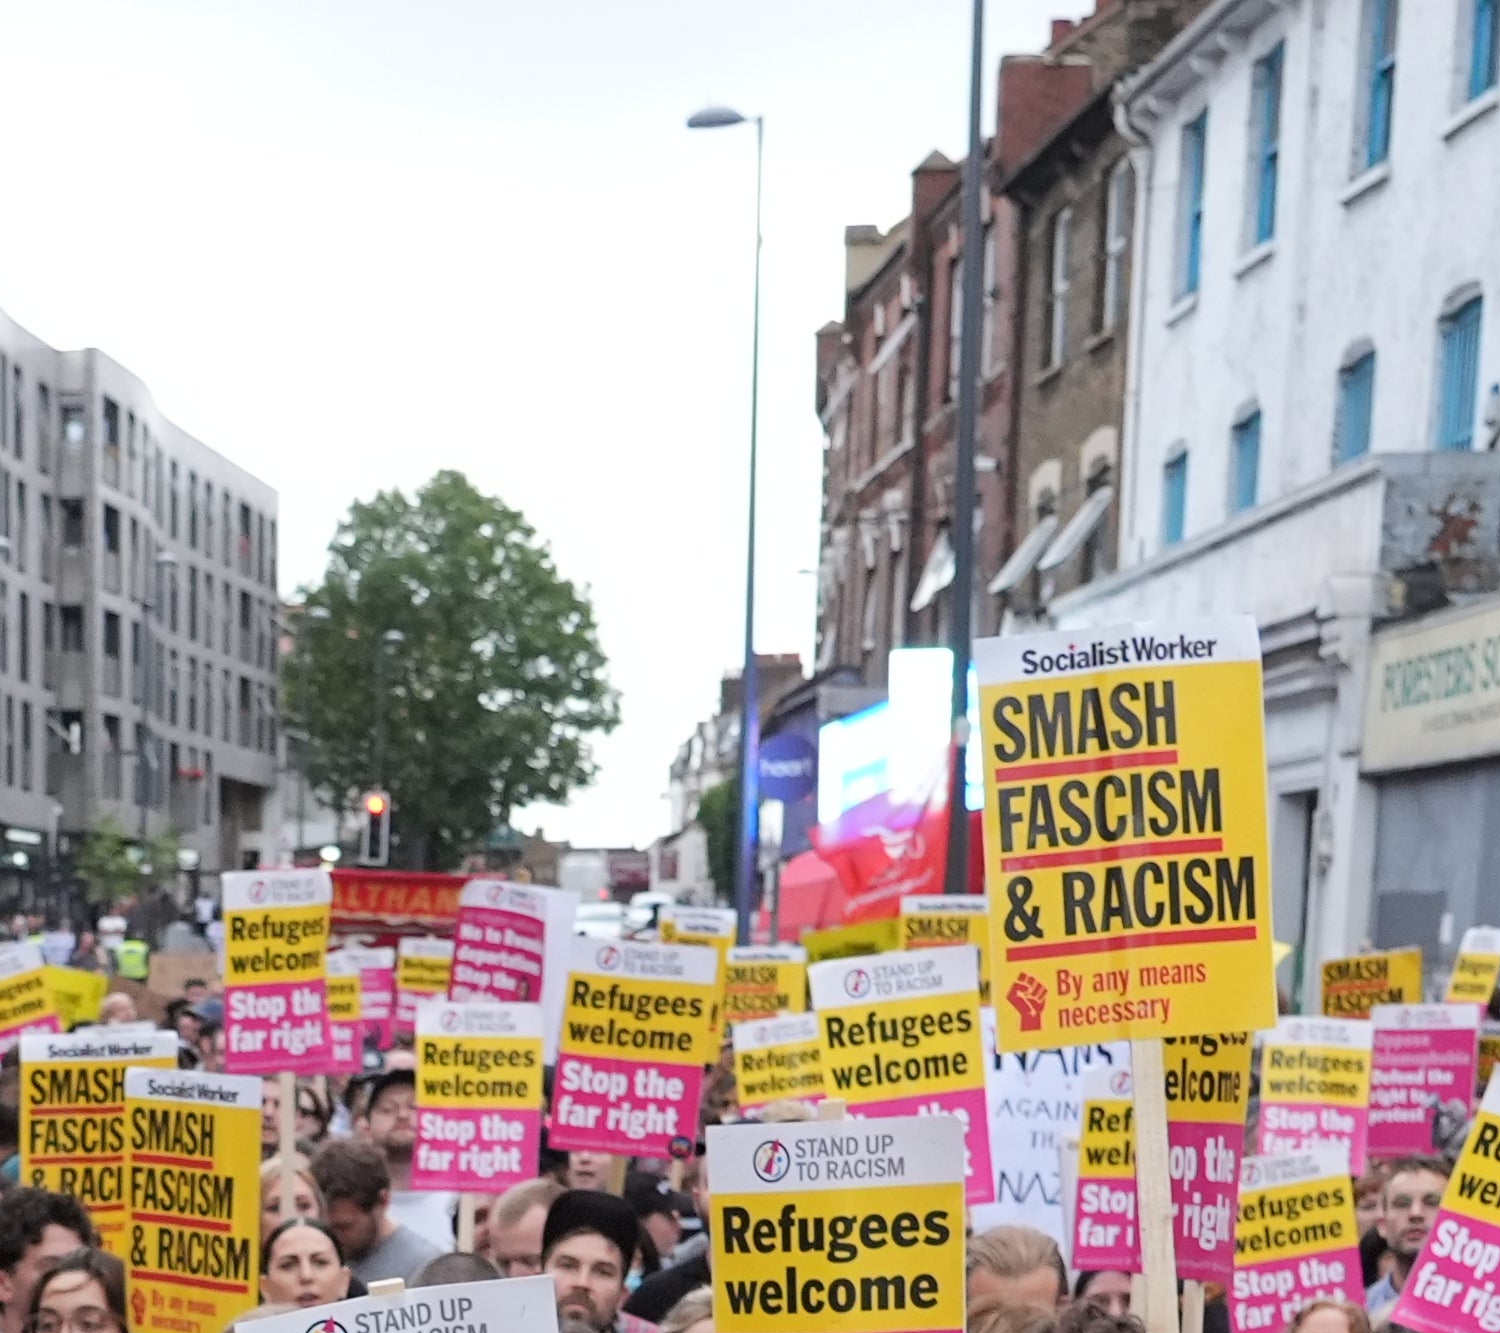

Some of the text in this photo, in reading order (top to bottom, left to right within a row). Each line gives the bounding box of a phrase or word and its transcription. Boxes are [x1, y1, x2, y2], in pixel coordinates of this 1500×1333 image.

[1022, 635, 1217, 676] Socialist Worker
[993, 680, 1178, 763] SMASH
[998, 768, 1223, 852] FASCISM
[1004, 876, 1043, 942] &
[1062, 856, 1256, 936] RACISM
[570, 980, 702, 1021] Refugees
[1056, 962, 1206, 1001] By any means
[825, 1009, 971, 1049] Refugees
[1058, 996, 1170, 1028] necessary
[568, 1014, 694, 1053] welcome
[423, 1042, 536, 1074] Refugees
[831, 1050, 968, 1090] welcome
[147, 1077, 239, 1103] Socialist Worker
[423, 1074, 528, 1098] welcome
[561, 1060, 685, 1102] Stop the
[130, 1107, 215, 1157] SMASH
[558, 1100, 680, 1140] far right
[130, 1166, 234, 1220] FASCISM
[130, 1225, 251, 1280] & RACISM
[722, 1204, 950, 1266] Refugees
[440, 1297, 472, 1322] UP
[725, 1267, 940, 1315] welcome
